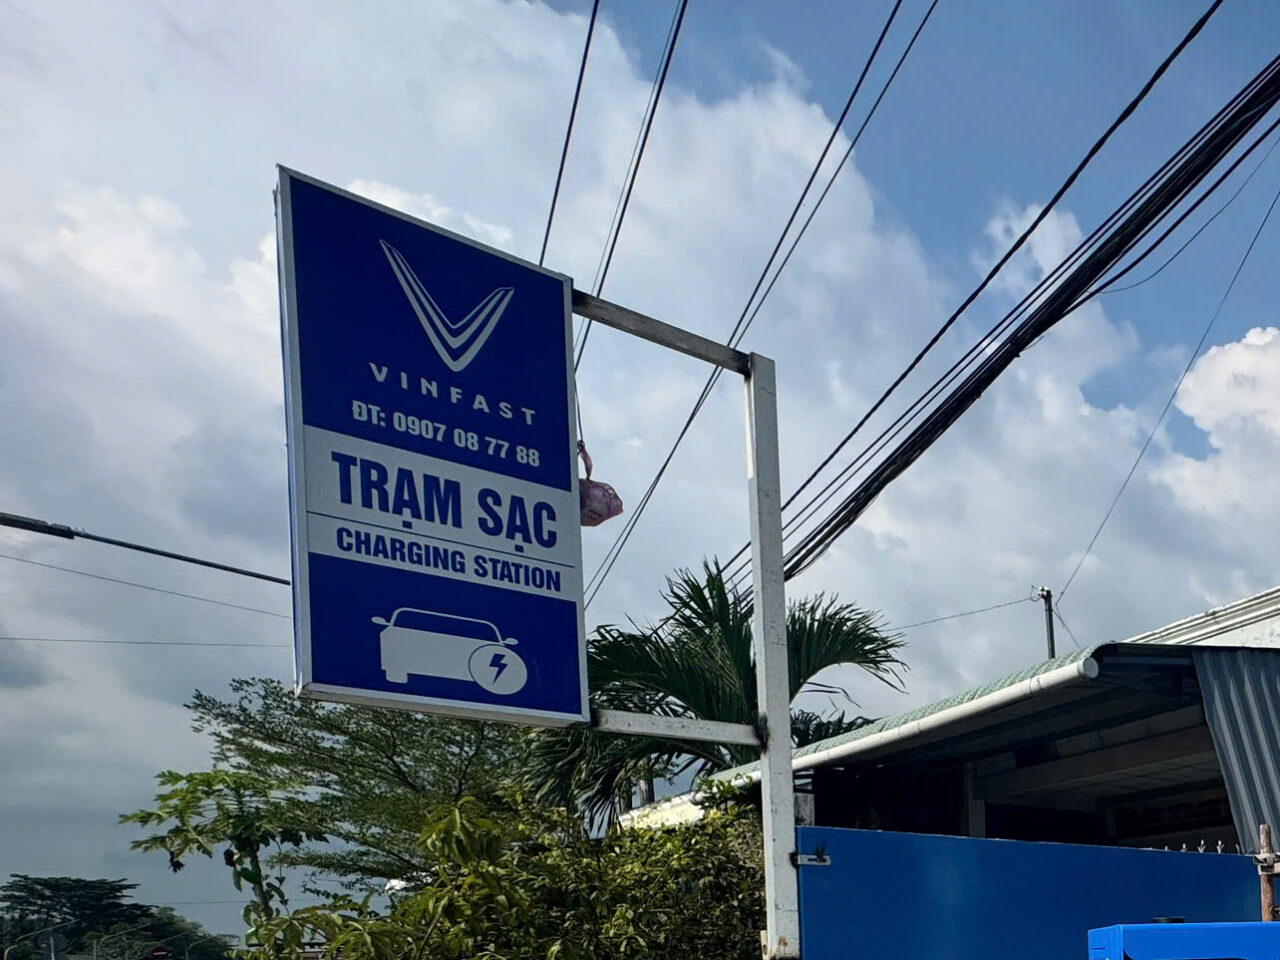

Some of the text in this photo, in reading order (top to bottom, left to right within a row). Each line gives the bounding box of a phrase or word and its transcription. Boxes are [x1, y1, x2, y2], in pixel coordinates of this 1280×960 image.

[369, 362, 535, 425] VINFAST
[352, 400, 540, 467] ĐT: 0907 08 77 88
[331, 451, 557, 553] TRẠM SẠC
[336, 527, 561, 592] CHARGING STATION
